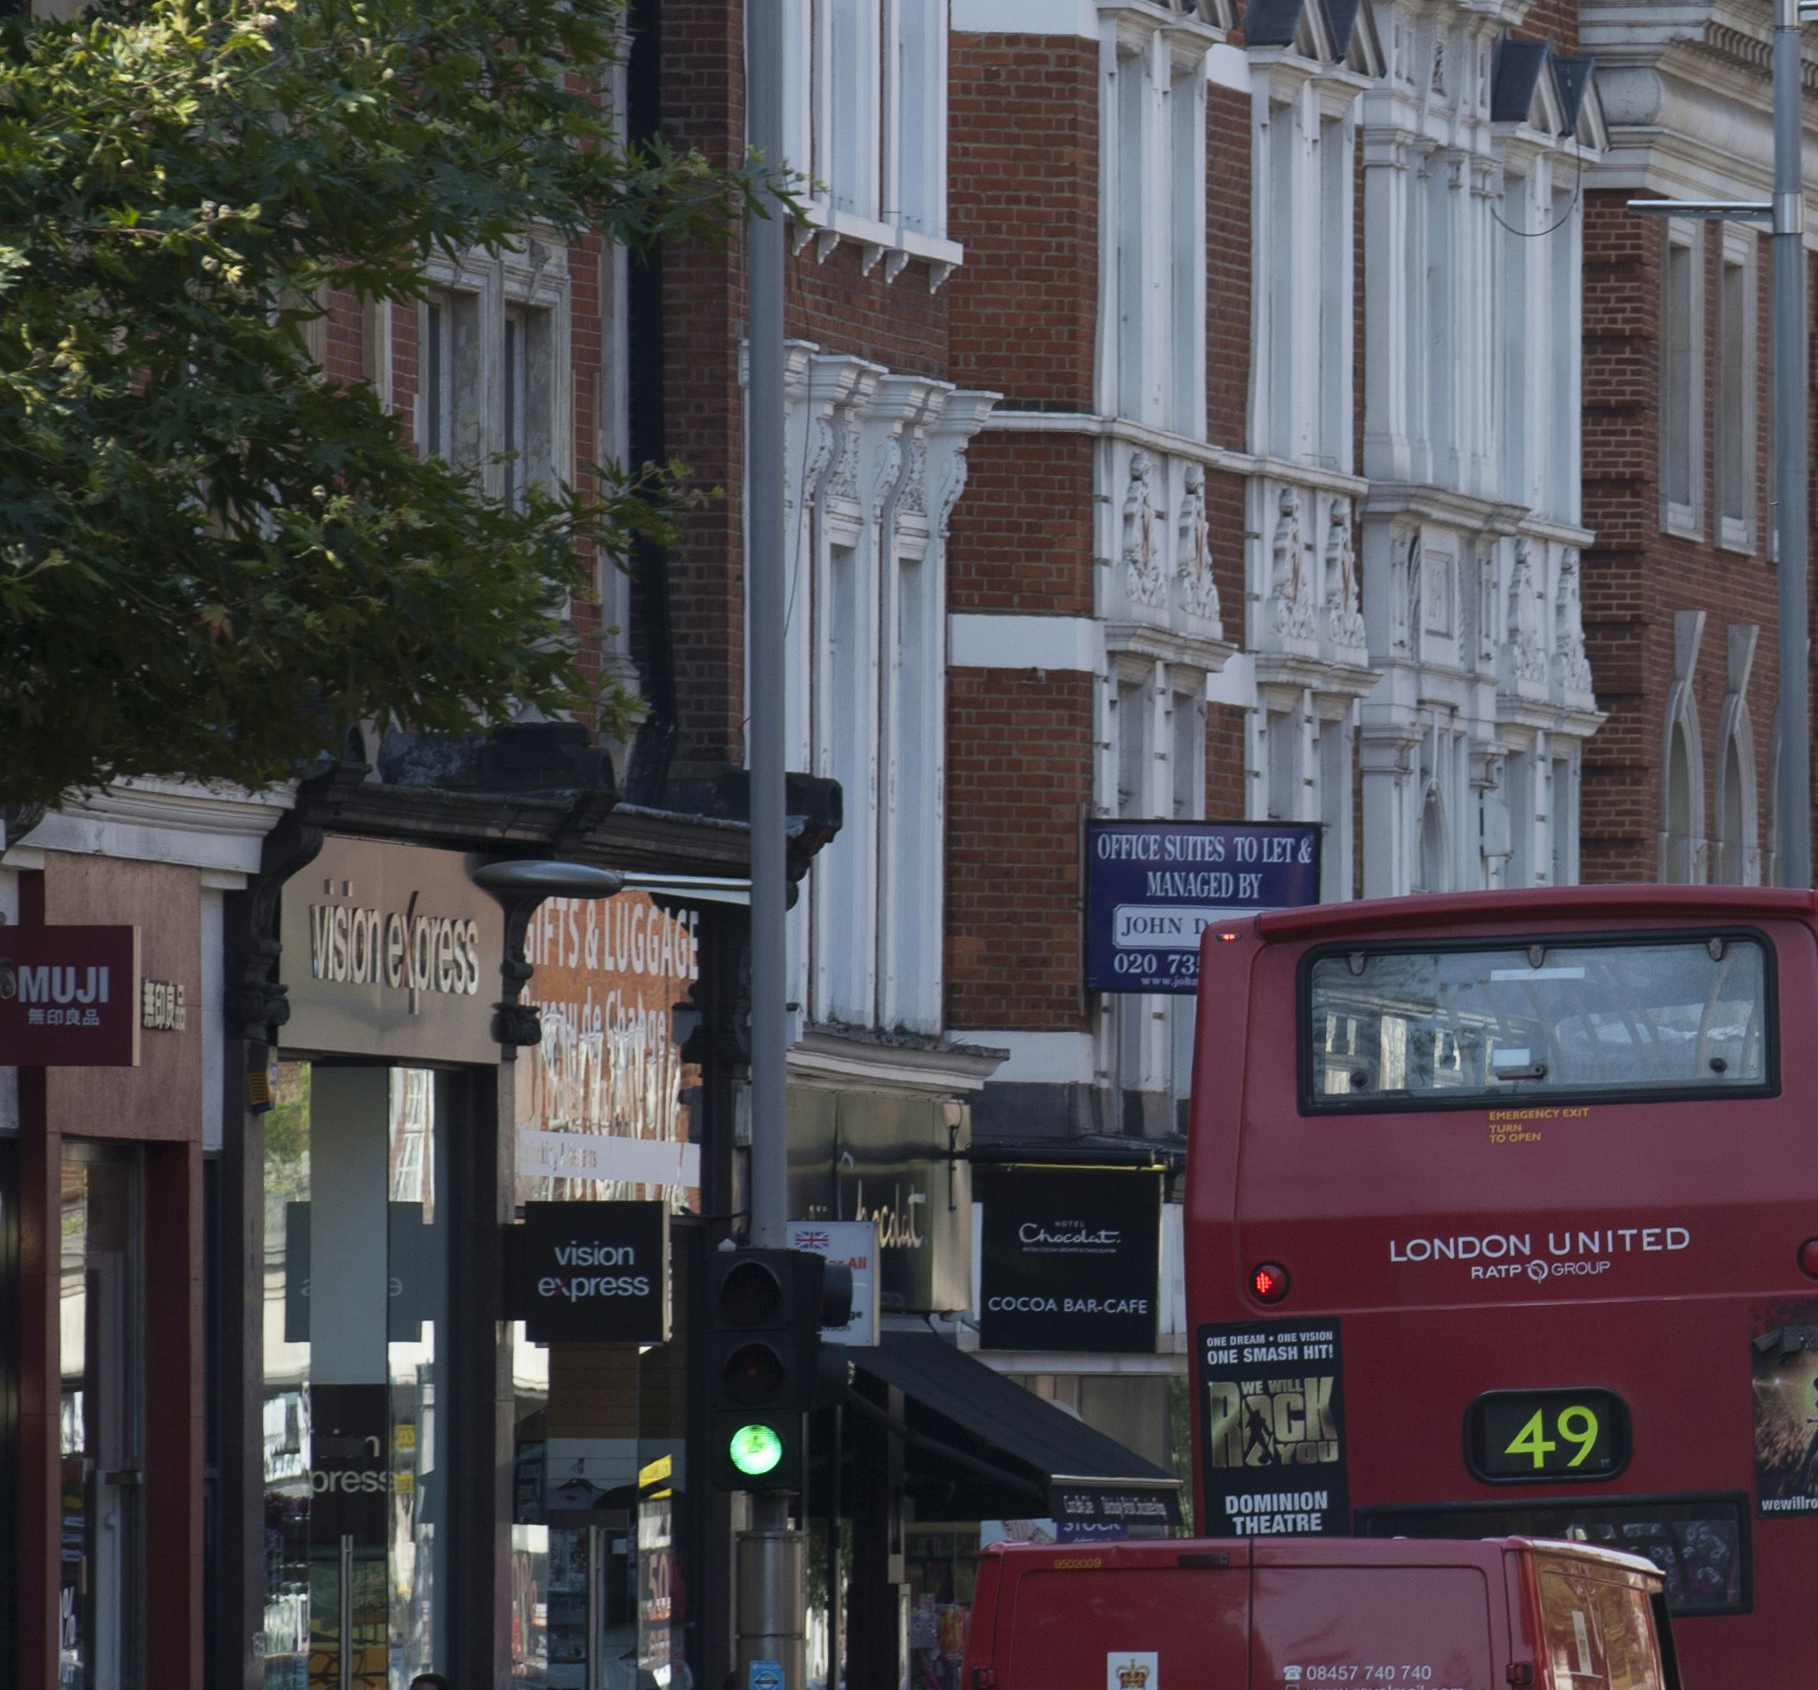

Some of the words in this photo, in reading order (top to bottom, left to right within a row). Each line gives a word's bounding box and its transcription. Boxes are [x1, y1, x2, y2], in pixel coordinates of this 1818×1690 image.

[1097, 834, 1160, 860] OFFICE
[1164, 835, 1226, 862] SUITES
[1233, 837, 1258, 863] TO
[1262, 837, 1296, 864] LET
[1298, 838, 1312, 864] &
[1146, 871, 1234, 898] MANAGED
[1238, 873, 1262, 899] BY
[1121, 916, 1183, 937] JOHN
[584, 898, 600, 971] &
[604, 900, 699, 981] LUGGAGE
[1113, 953, 1157, 974] 020
[18, 965, 109, 1004] MUJI
[28, 1008, 100, 1026] 無印良品
[1489, 1110, 1559, 1121] EMERGENCY
[1562, 1108, 1590, 1118] EXIT
[1489, 1124, 1522, 1134] TURN
[1489, 1134, 1506, 1144] TO
[1508, 1132, 1541, 1143] OPEN
[554, 1239, 635, 1266] vision
[1390, 1234, 1531, 1262] LONDON
[1549, 1227, 1690, 1256] UNITED
[1471, 1264, 1522, 1280] RATP
[1551, 1261, 1611, 1277] GROUP
[537, 1275, 650, 1302] express
[988, 1297, 1057, 1312] COCOA
[1064, 1299, 1148, 1314] BAR-CAFE
[1207, 1337, 1227, 1347] ONE
[1230, 1334, 1265, 1346] DREAM
[1277, 1333, 1297, 1343] ONE
[1300, 1331, 1333, 1342] VISION
[1207, 1349, 1238, 1365] ONE
[1243, 1346, 1298, 1362] SMASH
[1304, 1344, 1334, 1359] HIT!
[1241, 1381, 1264, 1395] WE
[1268, 1379, 1303, 1393] WILL
[1209, 1376, 1338, 1468] ROCK
[1504, 1405, 1598, 1468] 49
[1276, 1441, 1339, 1465] YOU
[310, 1469, 396, 1495] press
[1225, 1491, 1328, 1515] DOMINION
[1232, 1513, 1323, 1535] THEATRE
[1306, 1665, 1358, 1680] 08457
[1364, 1665, 1396, 1680] 740
[1401, 1665, 1432, 1680] 740
